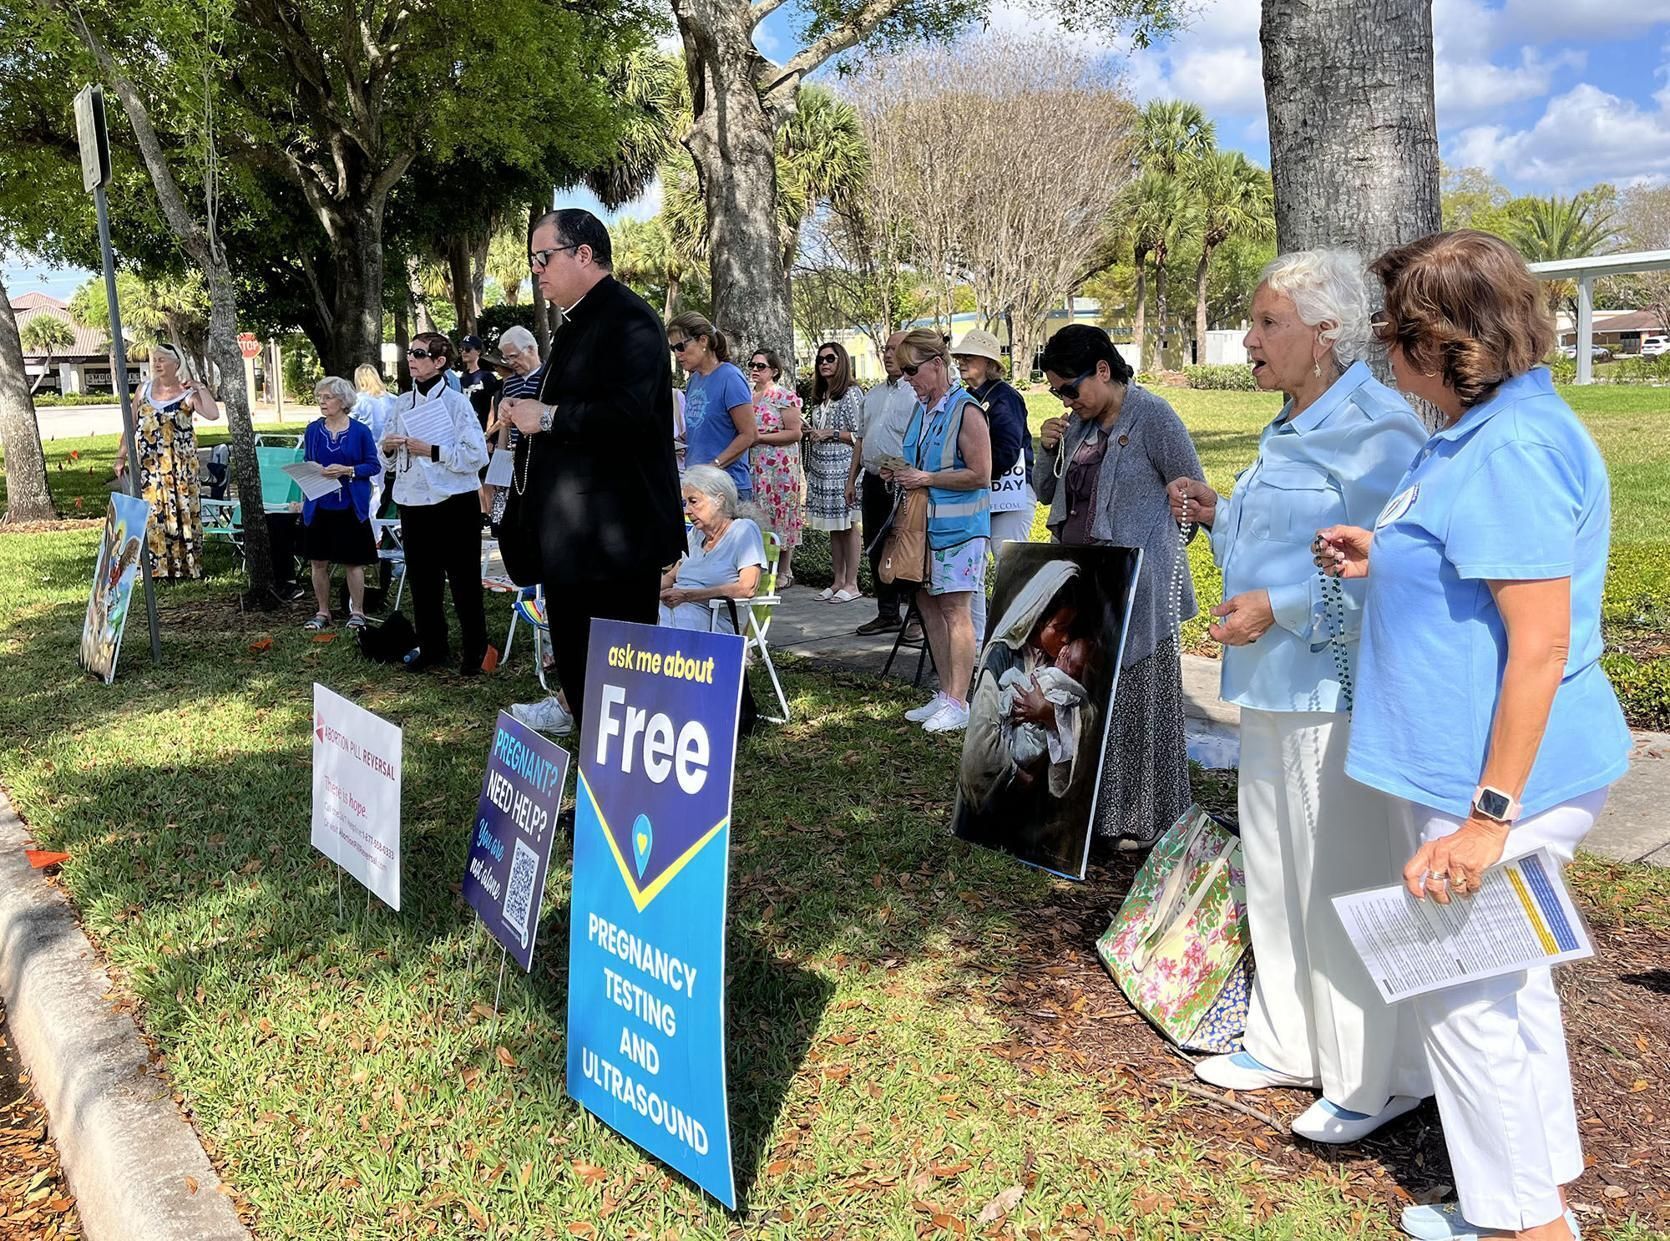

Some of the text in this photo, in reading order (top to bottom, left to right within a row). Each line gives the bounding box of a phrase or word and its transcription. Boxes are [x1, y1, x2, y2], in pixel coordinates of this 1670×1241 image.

[240, 340, 259, 351] TOP
[608, 643, 715, 684] ask me about
[325, 725, 396, 781] ABORTION PILL REVERSAL
[494, 728, 558, 797] PREGNANT?
[596, 684, 710, 795] Free
[324, 775, 343, 800] There
[342, 787, 349, 804] is
[486, 769, 548, 842] NEED HELP?
[476, 818, 504, 863] You are
[469, 857, 501, 901] not alone
[588, 912, 697, 999] PREGNANCY
[604, 967, 676, 1038] TESTING
[619, 1026, 660, 1076] AND
[582, 1046, 709, 1156] ULTRASOUND
